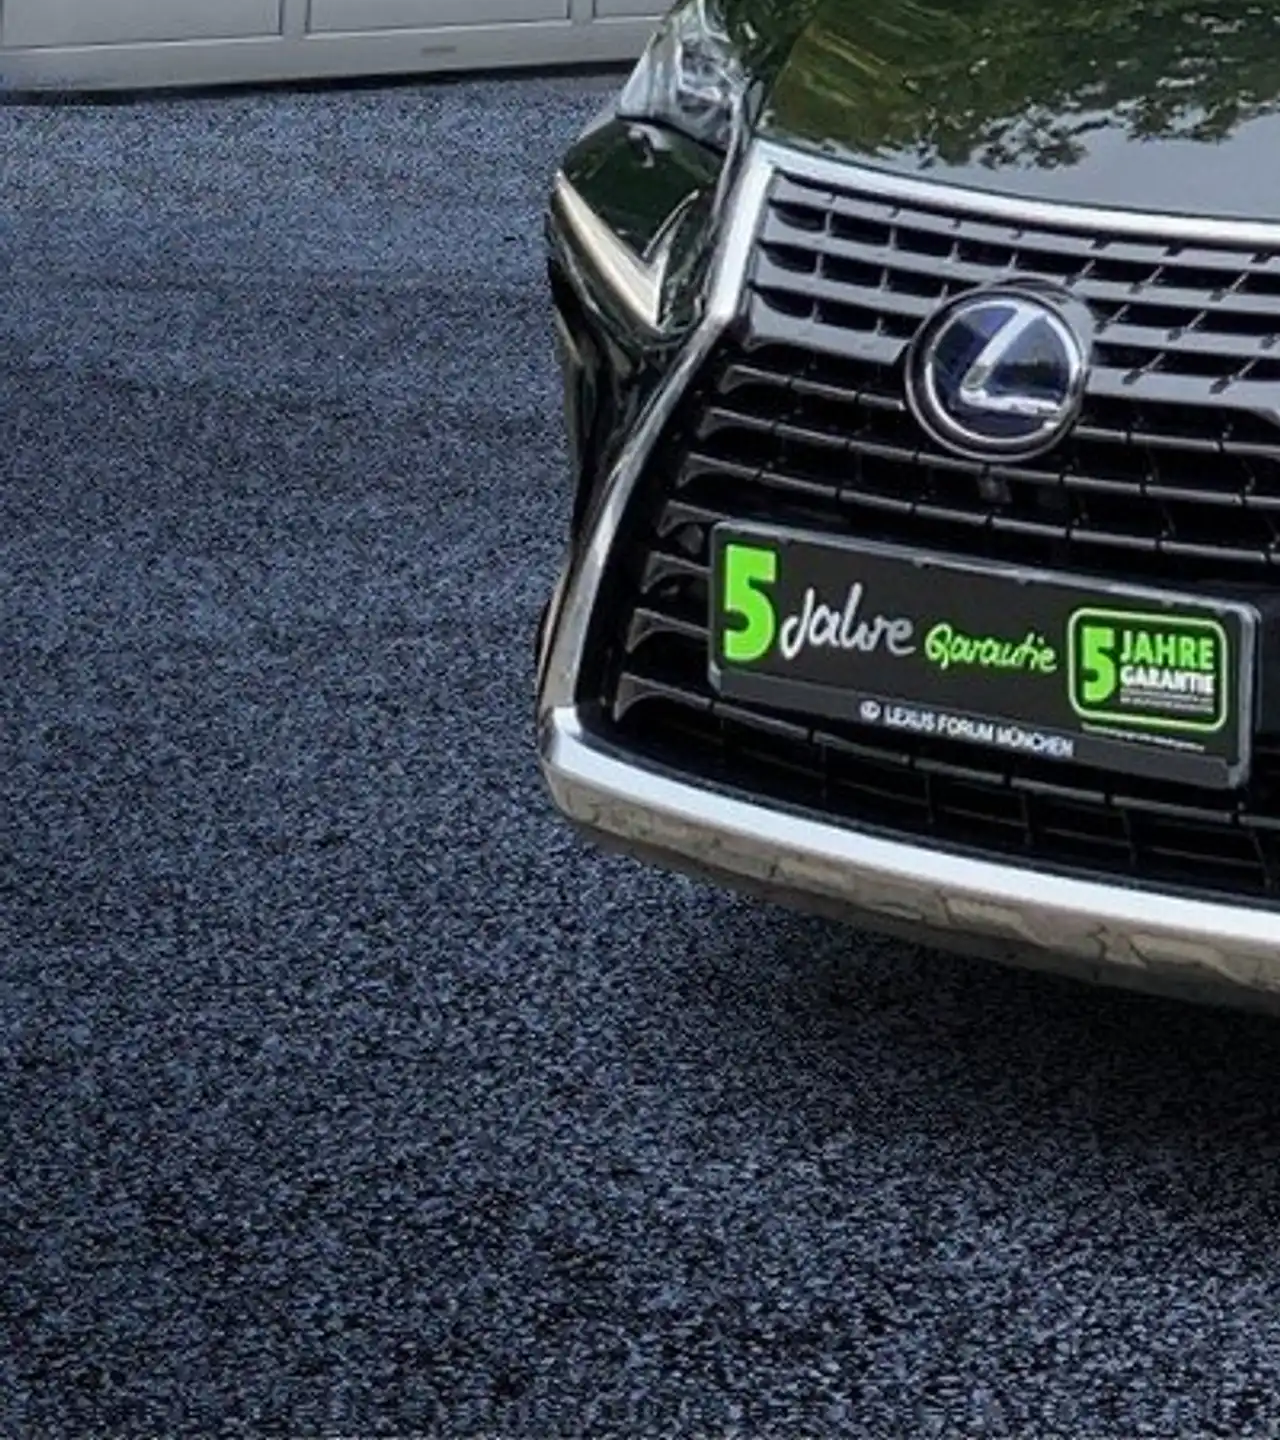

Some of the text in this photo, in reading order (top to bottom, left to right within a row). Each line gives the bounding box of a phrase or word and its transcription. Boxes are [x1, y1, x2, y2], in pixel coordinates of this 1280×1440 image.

[724, 543, 1057, 673] 5 Jahre Garantie
[1081, 626, 1117, 703] 5
[1120, 630, 1215, 670] JAHRE
[1120, 664, 1216, 696] GARANTIE
[884, 703, 936, 733] LEXUS
[937, 714, 994, 741] FORUM
[995, 724, 1075, 758] MÜNCHEN
